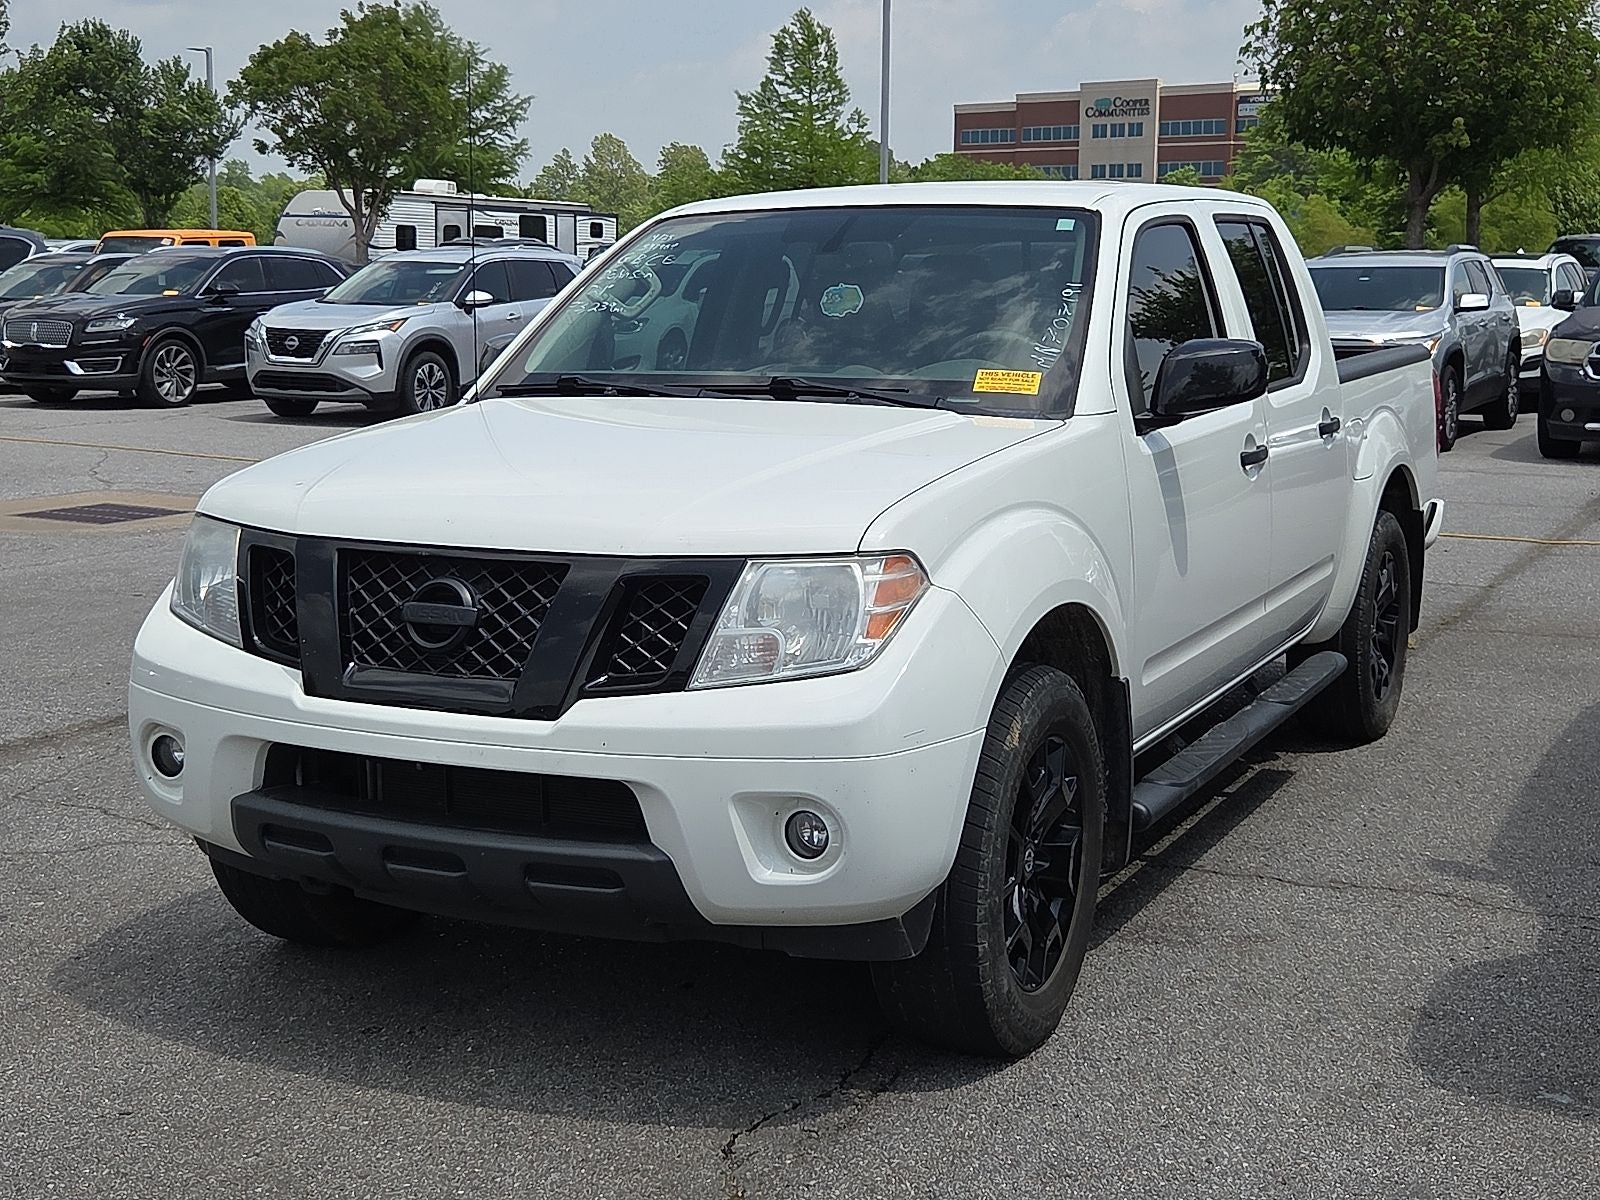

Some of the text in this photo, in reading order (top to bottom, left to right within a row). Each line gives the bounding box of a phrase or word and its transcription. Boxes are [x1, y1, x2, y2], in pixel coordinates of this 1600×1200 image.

[1113, 97, 1149, 108] COOPER
[1085, 107, 1150, 118] COMMUNITIES
[295, 219, 348, 227] CATALINA
[1001, 371, 1037, 379] VEHICLE
